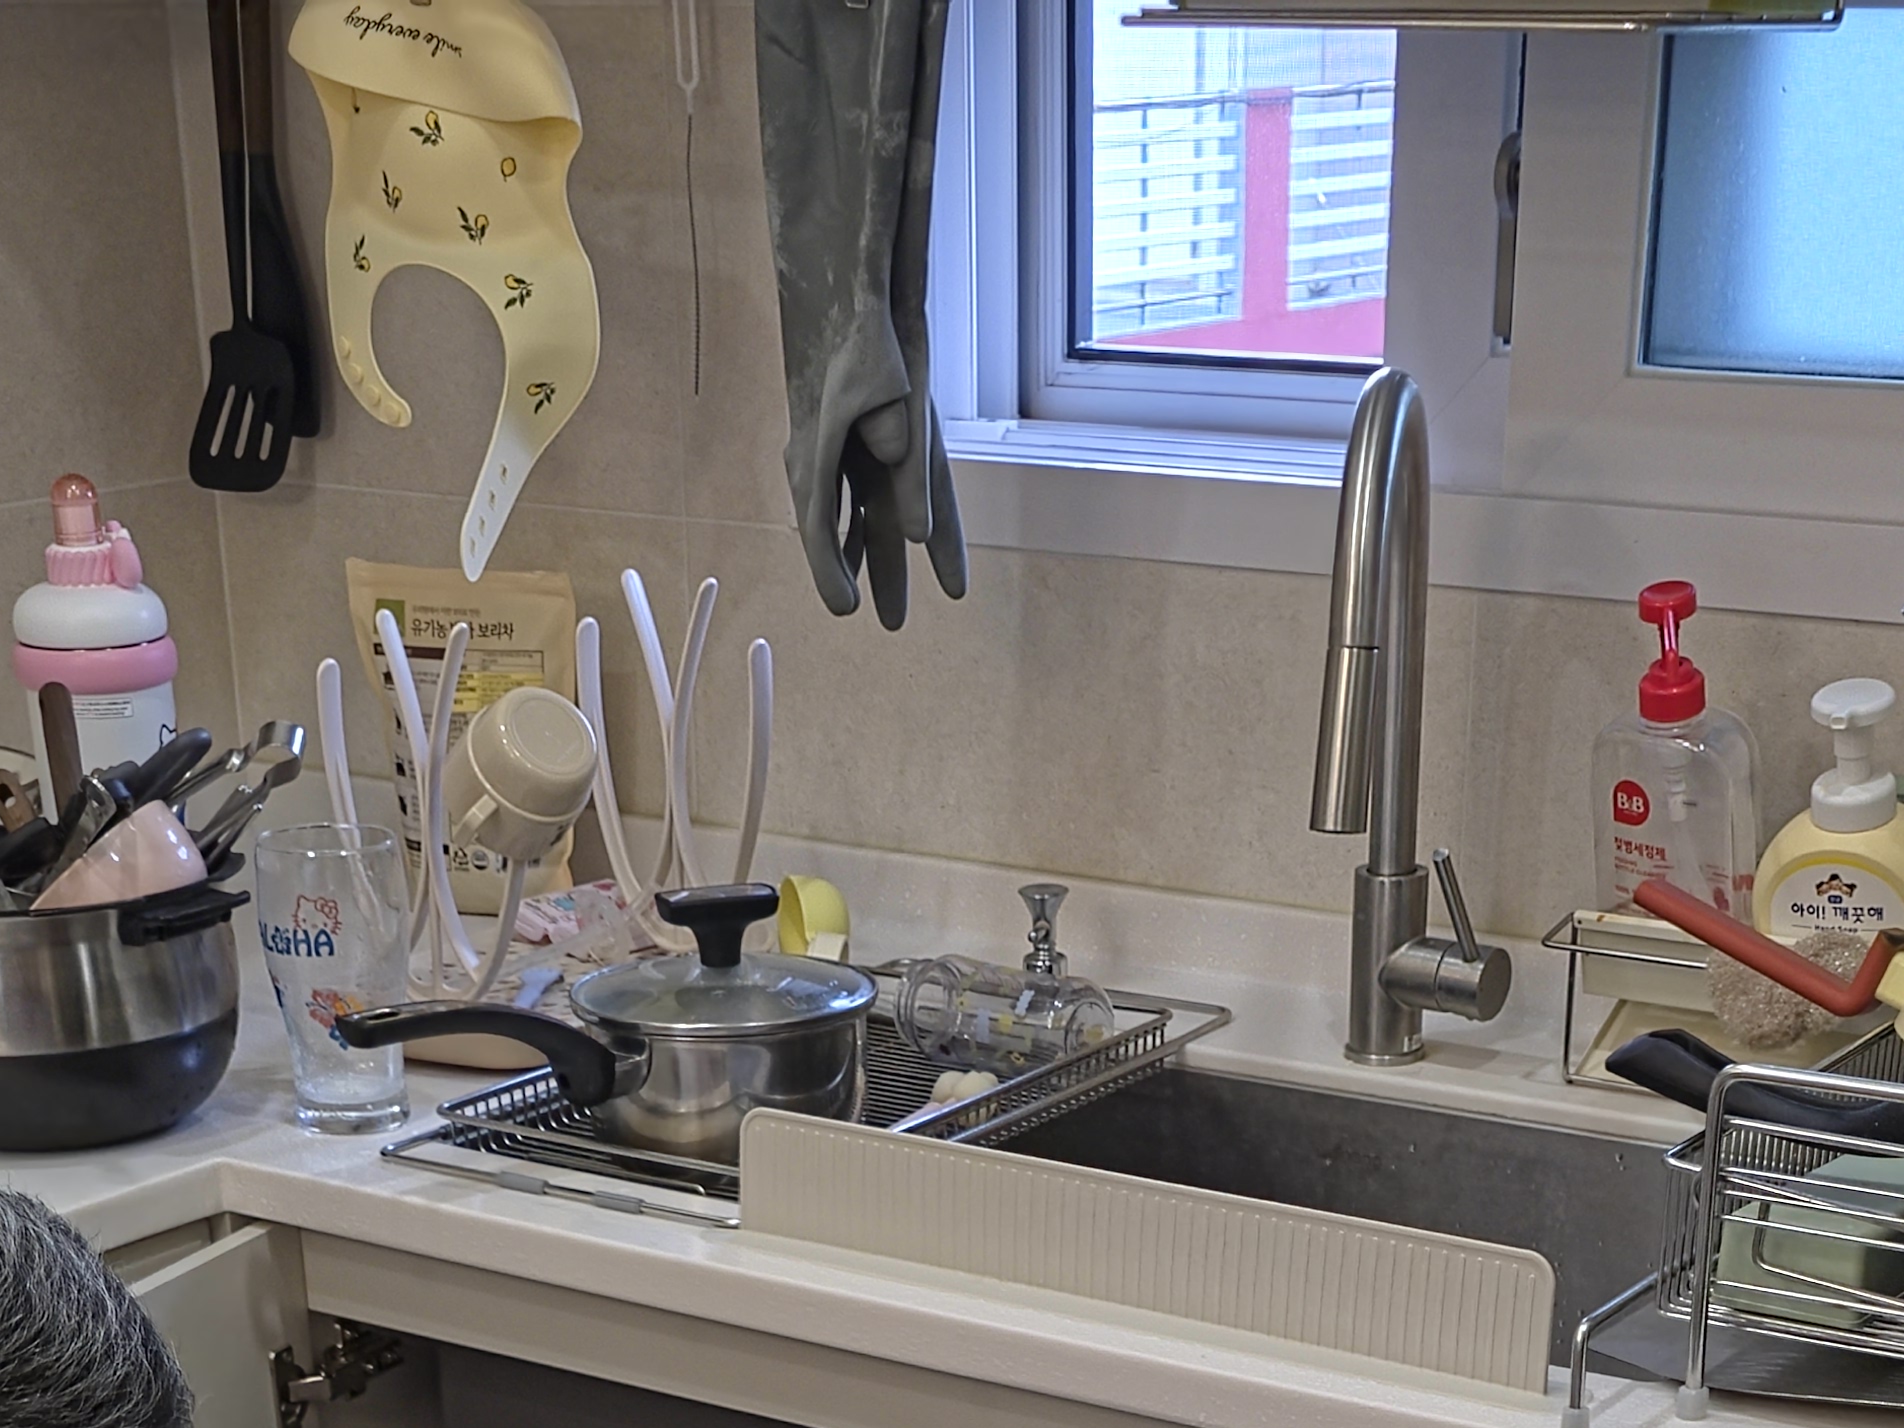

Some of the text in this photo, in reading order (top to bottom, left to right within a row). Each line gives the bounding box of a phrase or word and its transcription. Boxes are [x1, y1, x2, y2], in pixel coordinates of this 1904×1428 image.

[343, 5, 421, 41] everyday
[411, 618, 448, 639] 유기농
[477, 621, 514, 641] 보리차
[1791, 902, 1884, 924] 아이! 깨끗해
